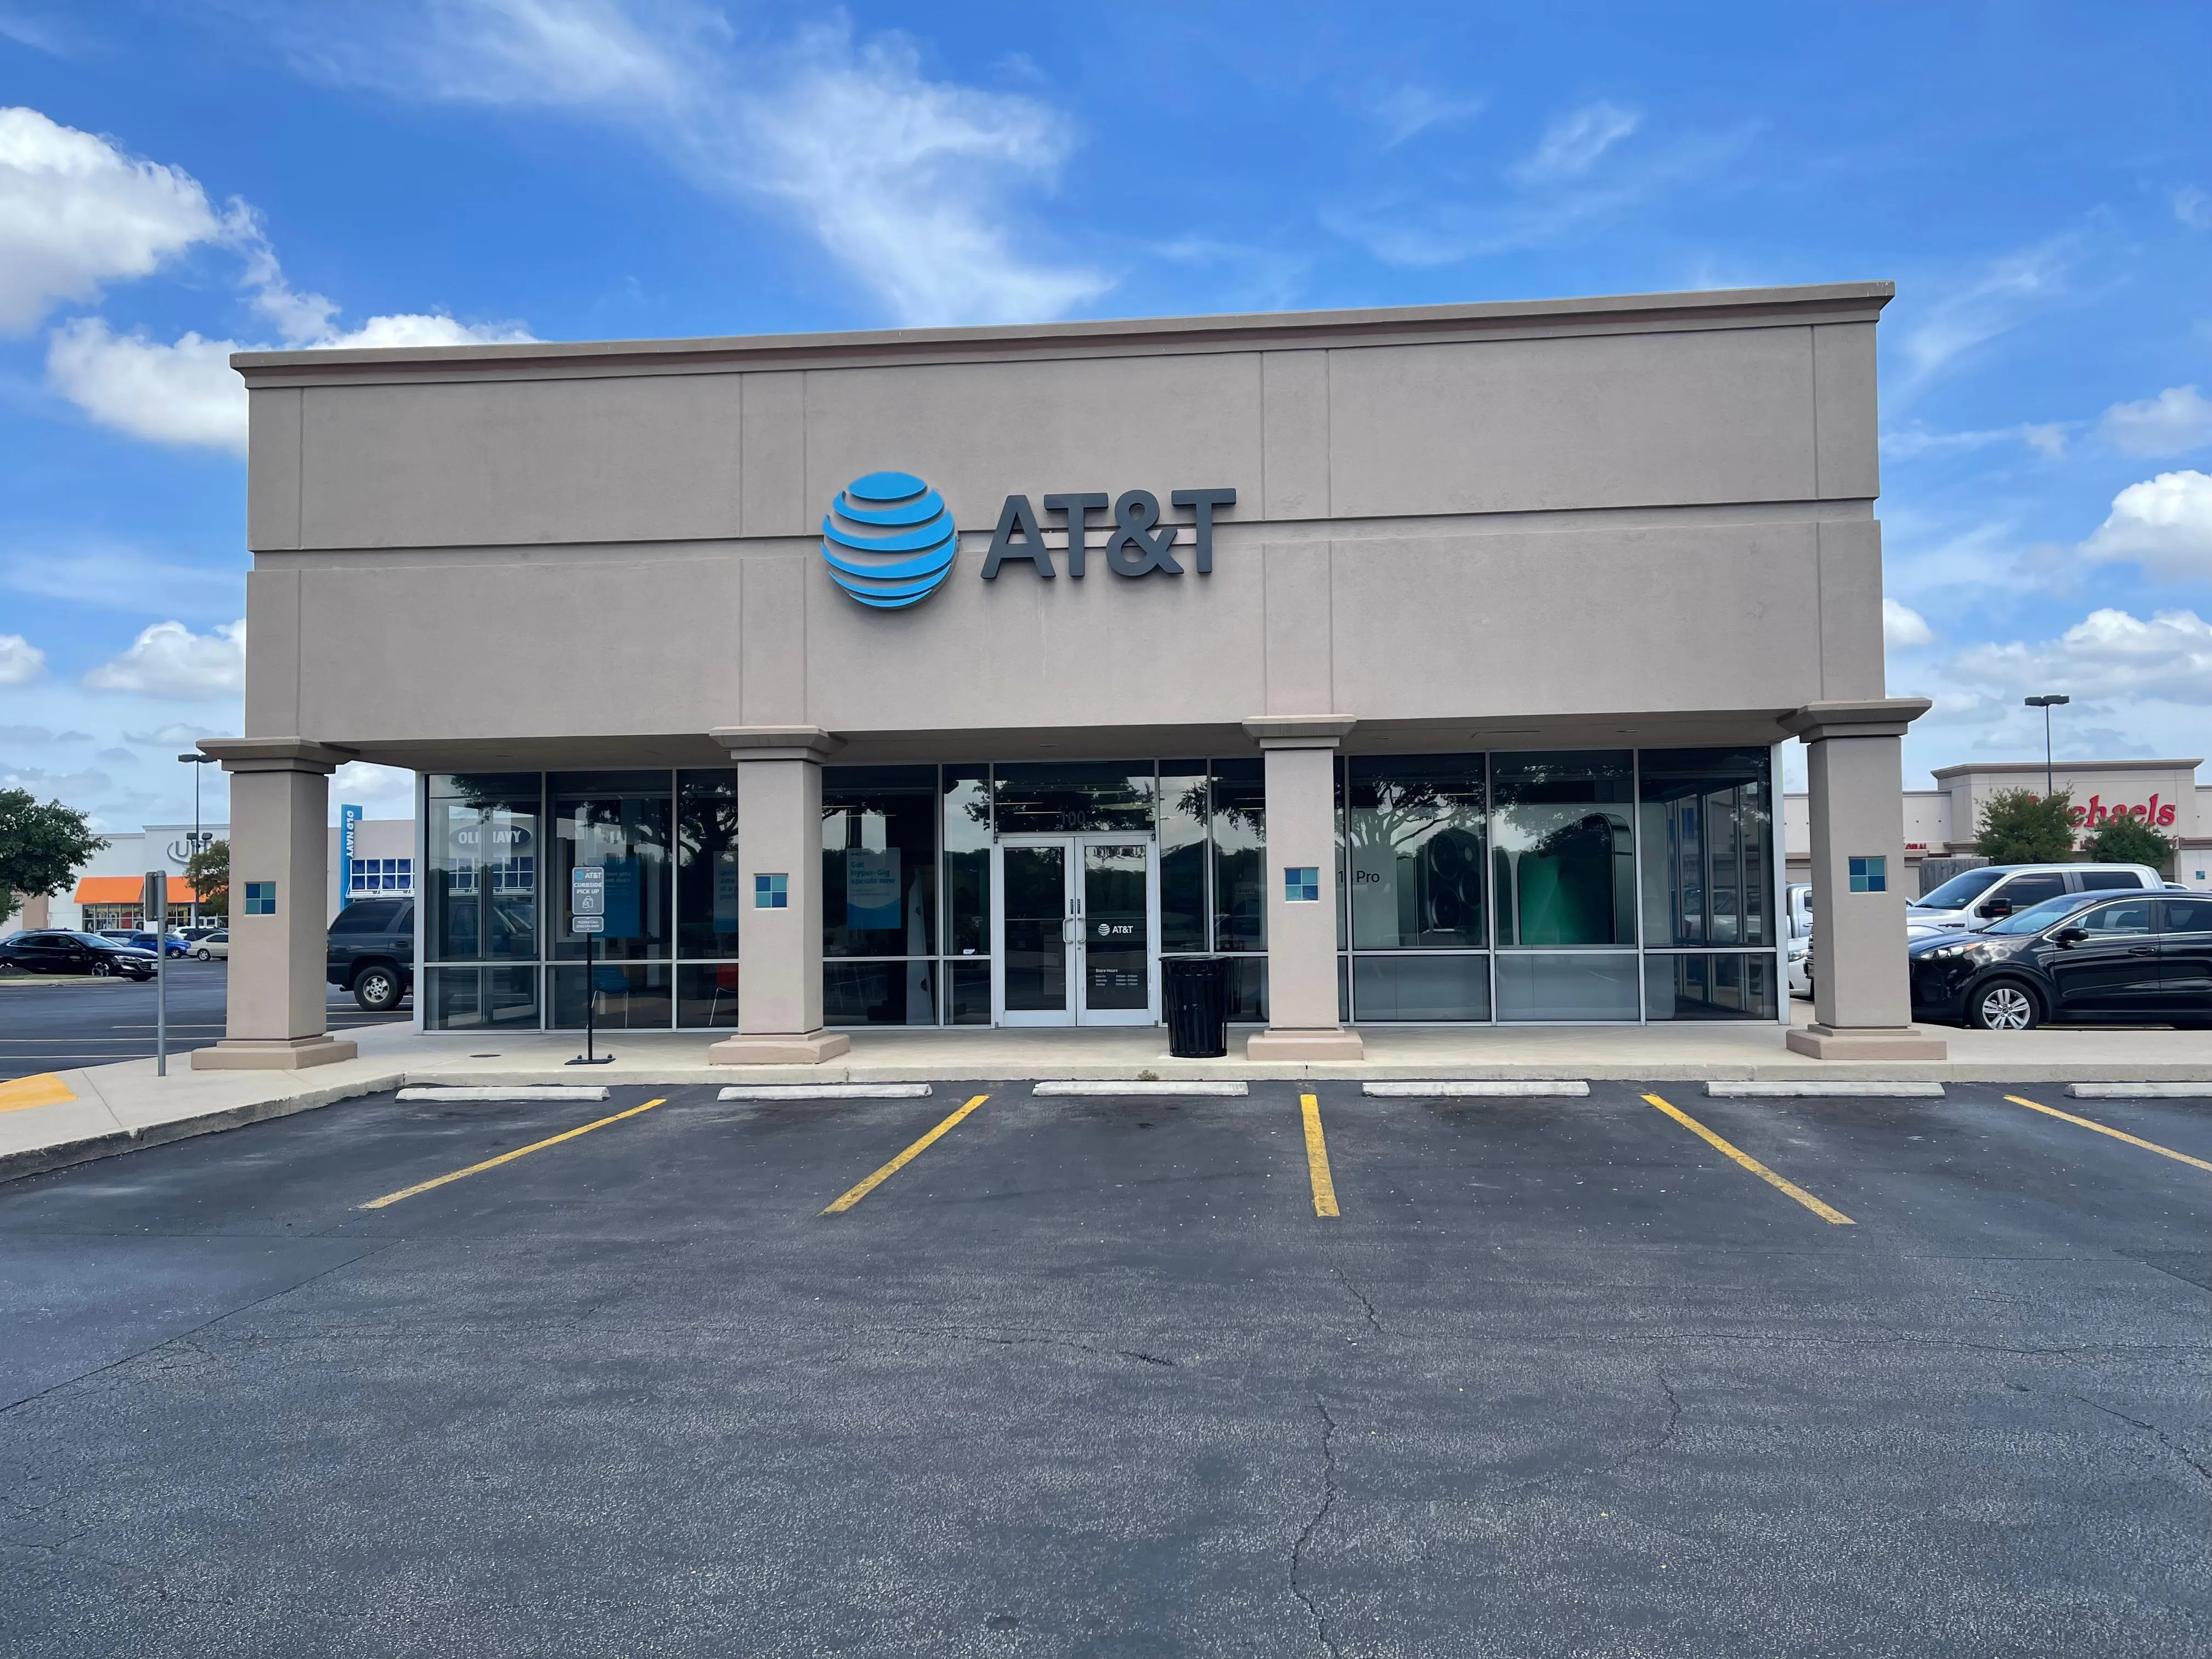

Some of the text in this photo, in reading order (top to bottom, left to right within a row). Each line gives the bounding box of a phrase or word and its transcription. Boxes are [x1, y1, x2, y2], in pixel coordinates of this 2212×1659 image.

[981, 488, 1237, 579] AT&T
[1062, 810, 1086, 825] 100
[1357, 871, 1380, 883] Pro
[1112, 926, 1133, 934] AT&T
